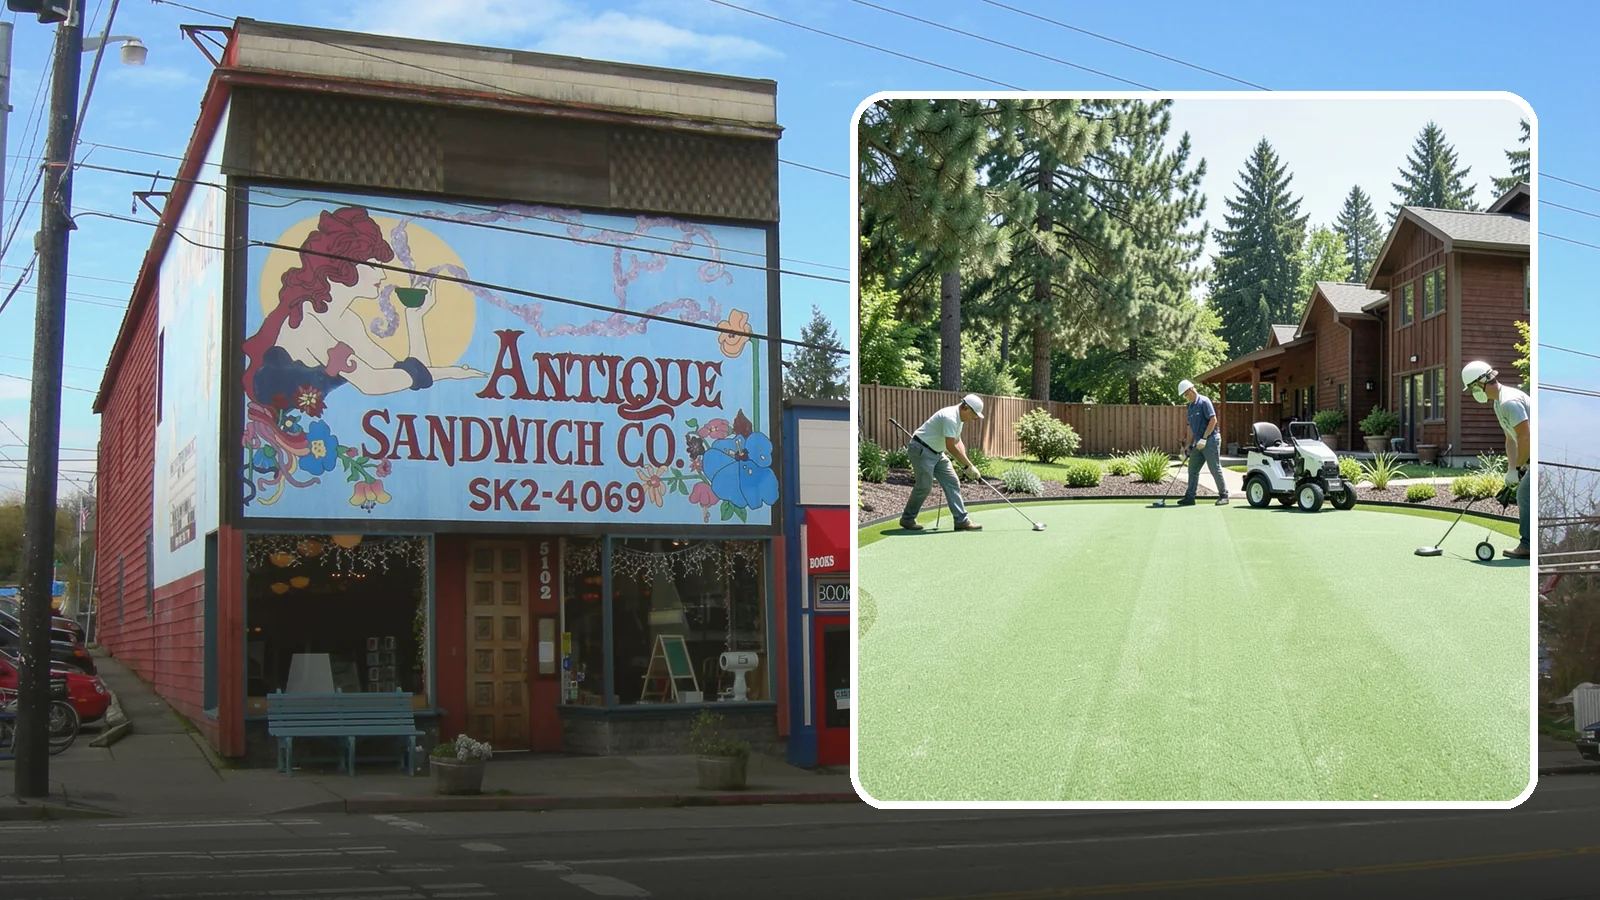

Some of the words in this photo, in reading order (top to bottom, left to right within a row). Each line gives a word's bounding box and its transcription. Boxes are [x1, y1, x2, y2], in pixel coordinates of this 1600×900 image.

[476, 329, 723, 420] ANTIQUE
[361, 408, 605, 468] SANDWICH
[617, 421, 686, 468] CO.
[468, 477, 646, 513] SK2-4069
[539, 542, 551, 600] 5102
[809, 555, 835, 569] BOOKS
